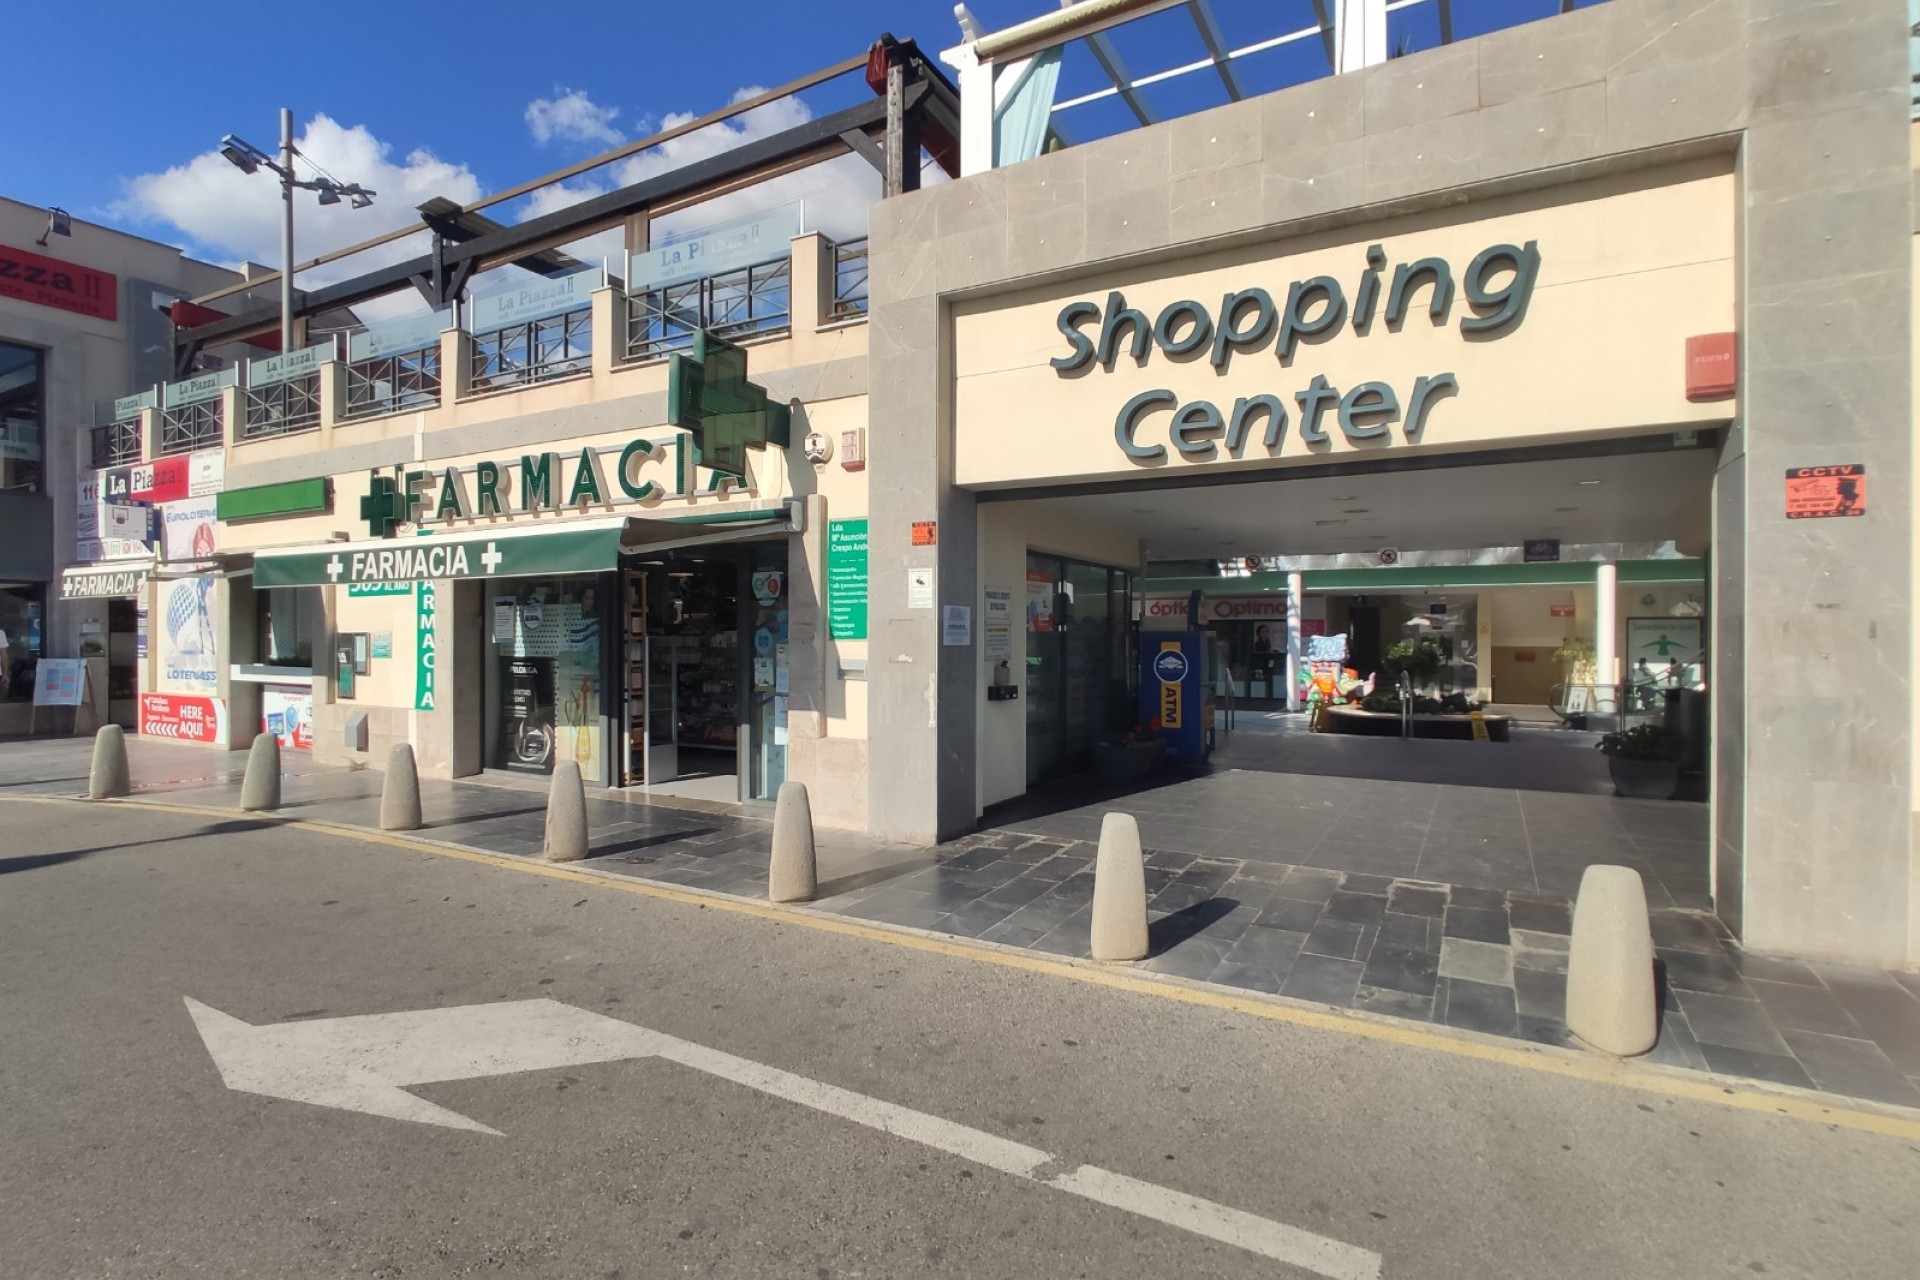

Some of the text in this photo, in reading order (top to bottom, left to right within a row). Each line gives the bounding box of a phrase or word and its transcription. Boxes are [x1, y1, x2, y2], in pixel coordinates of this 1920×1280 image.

[661, 250, 681, 267] La
[499, 296, 514, 311] La
[1049, 239, 1542, 372] Shopping
[266, 361, 278, 373] La
[191, 379, 216, 393] Piazza
[1114, 372, 1458, 459] Center
[1798, 466, 1852, 477] CCTV
[110, 475, 126, 495] La
[133, 469, 175, 490] Piazza
[351, 545, 469, 580] FARMACIA
[73, 572, 134, 596] FARMACIA
[420, 580, 435, 707] ARMACIA
[180, 705, 203, 719] HERE
[1165, 687, 1177, 723] ATM
[179, 721, 204, 738] AQUI
